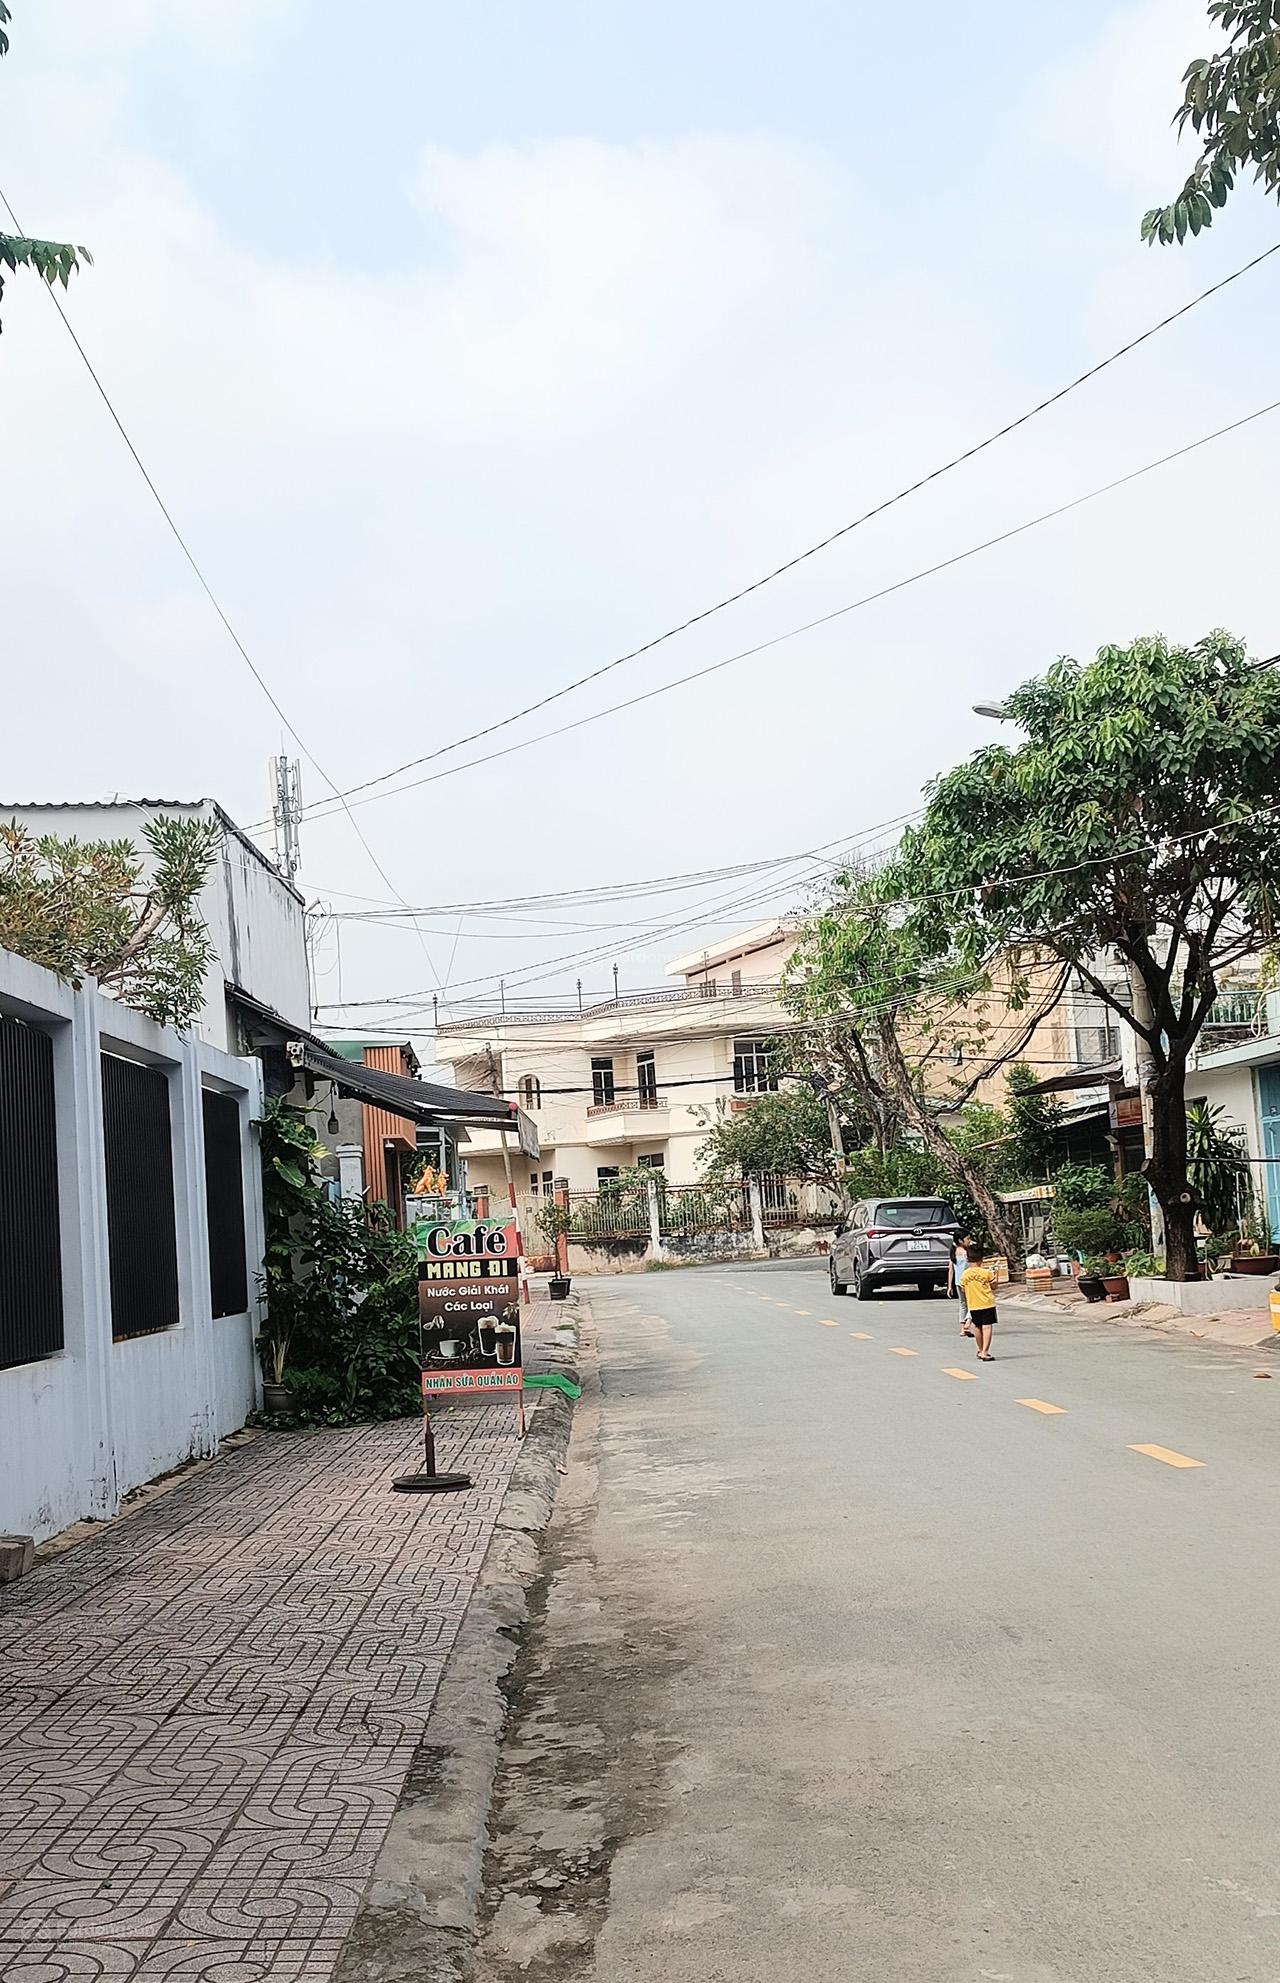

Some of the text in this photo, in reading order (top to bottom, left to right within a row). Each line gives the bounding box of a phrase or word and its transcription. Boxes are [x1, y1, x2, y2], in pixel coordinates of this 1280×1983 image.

[427, 1225, 506, 1257] Café
[427, 1260, 508, 1279] MANG ĐI
[427, 1283, 509, 1297] Nước Giải Khát
[444, 1300, 493, 1312] Các Loại
[505, 1372, 519, 1386] ÁO
